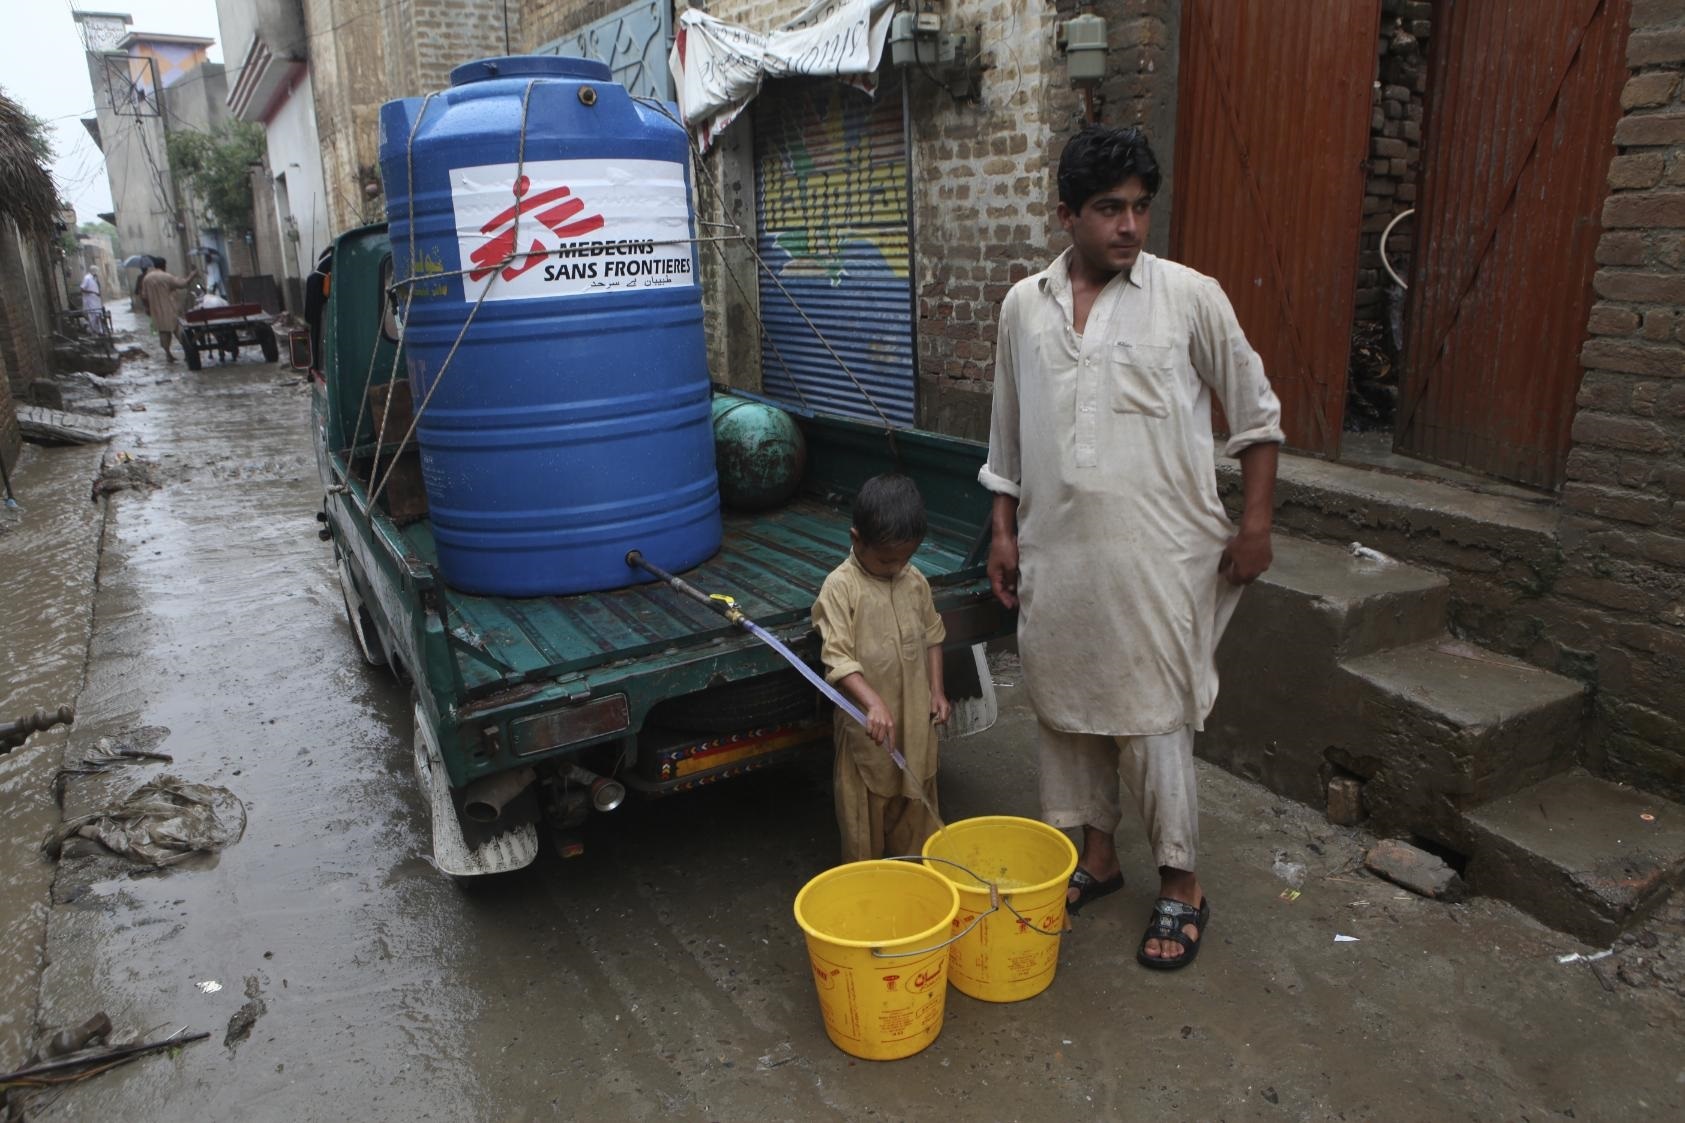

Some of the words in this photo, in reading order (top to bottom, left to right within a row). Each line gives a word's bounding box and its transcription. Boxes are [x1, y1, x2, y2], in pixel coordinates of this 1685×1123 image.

[559, 239, 654, 259] MEDECINS
[544, 262, 598, 281] SANS
[604, 258, 691, 277] FRONTIERES
